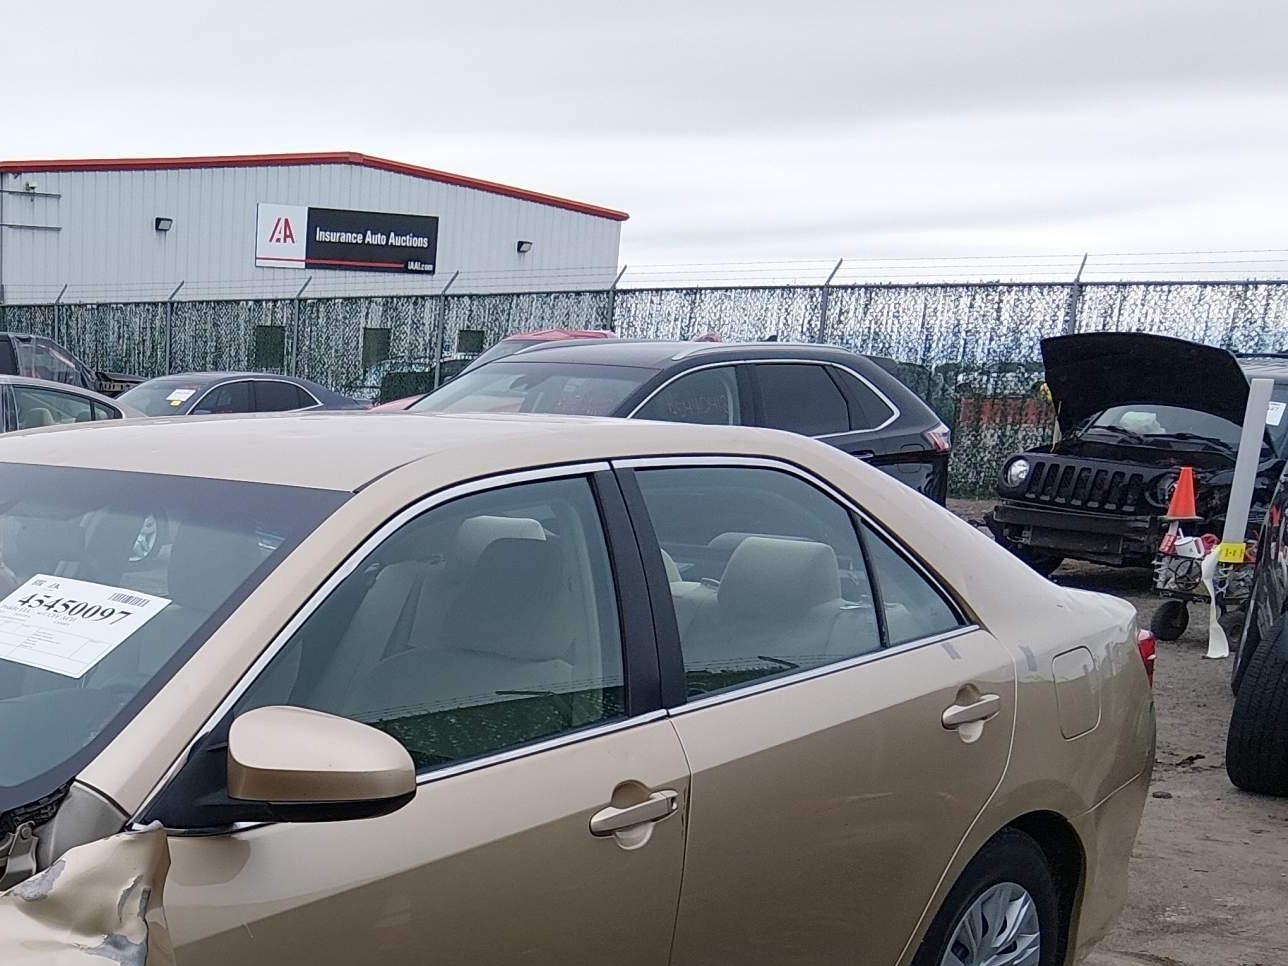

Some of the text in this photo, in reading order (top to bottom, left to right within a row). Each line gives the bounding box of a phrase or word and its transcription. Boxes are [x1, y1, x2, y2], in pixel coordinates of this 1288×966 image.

[315, 226, 429, 248] Insurance Auto Auctions
[18, 593, 133, 625] 45450097
